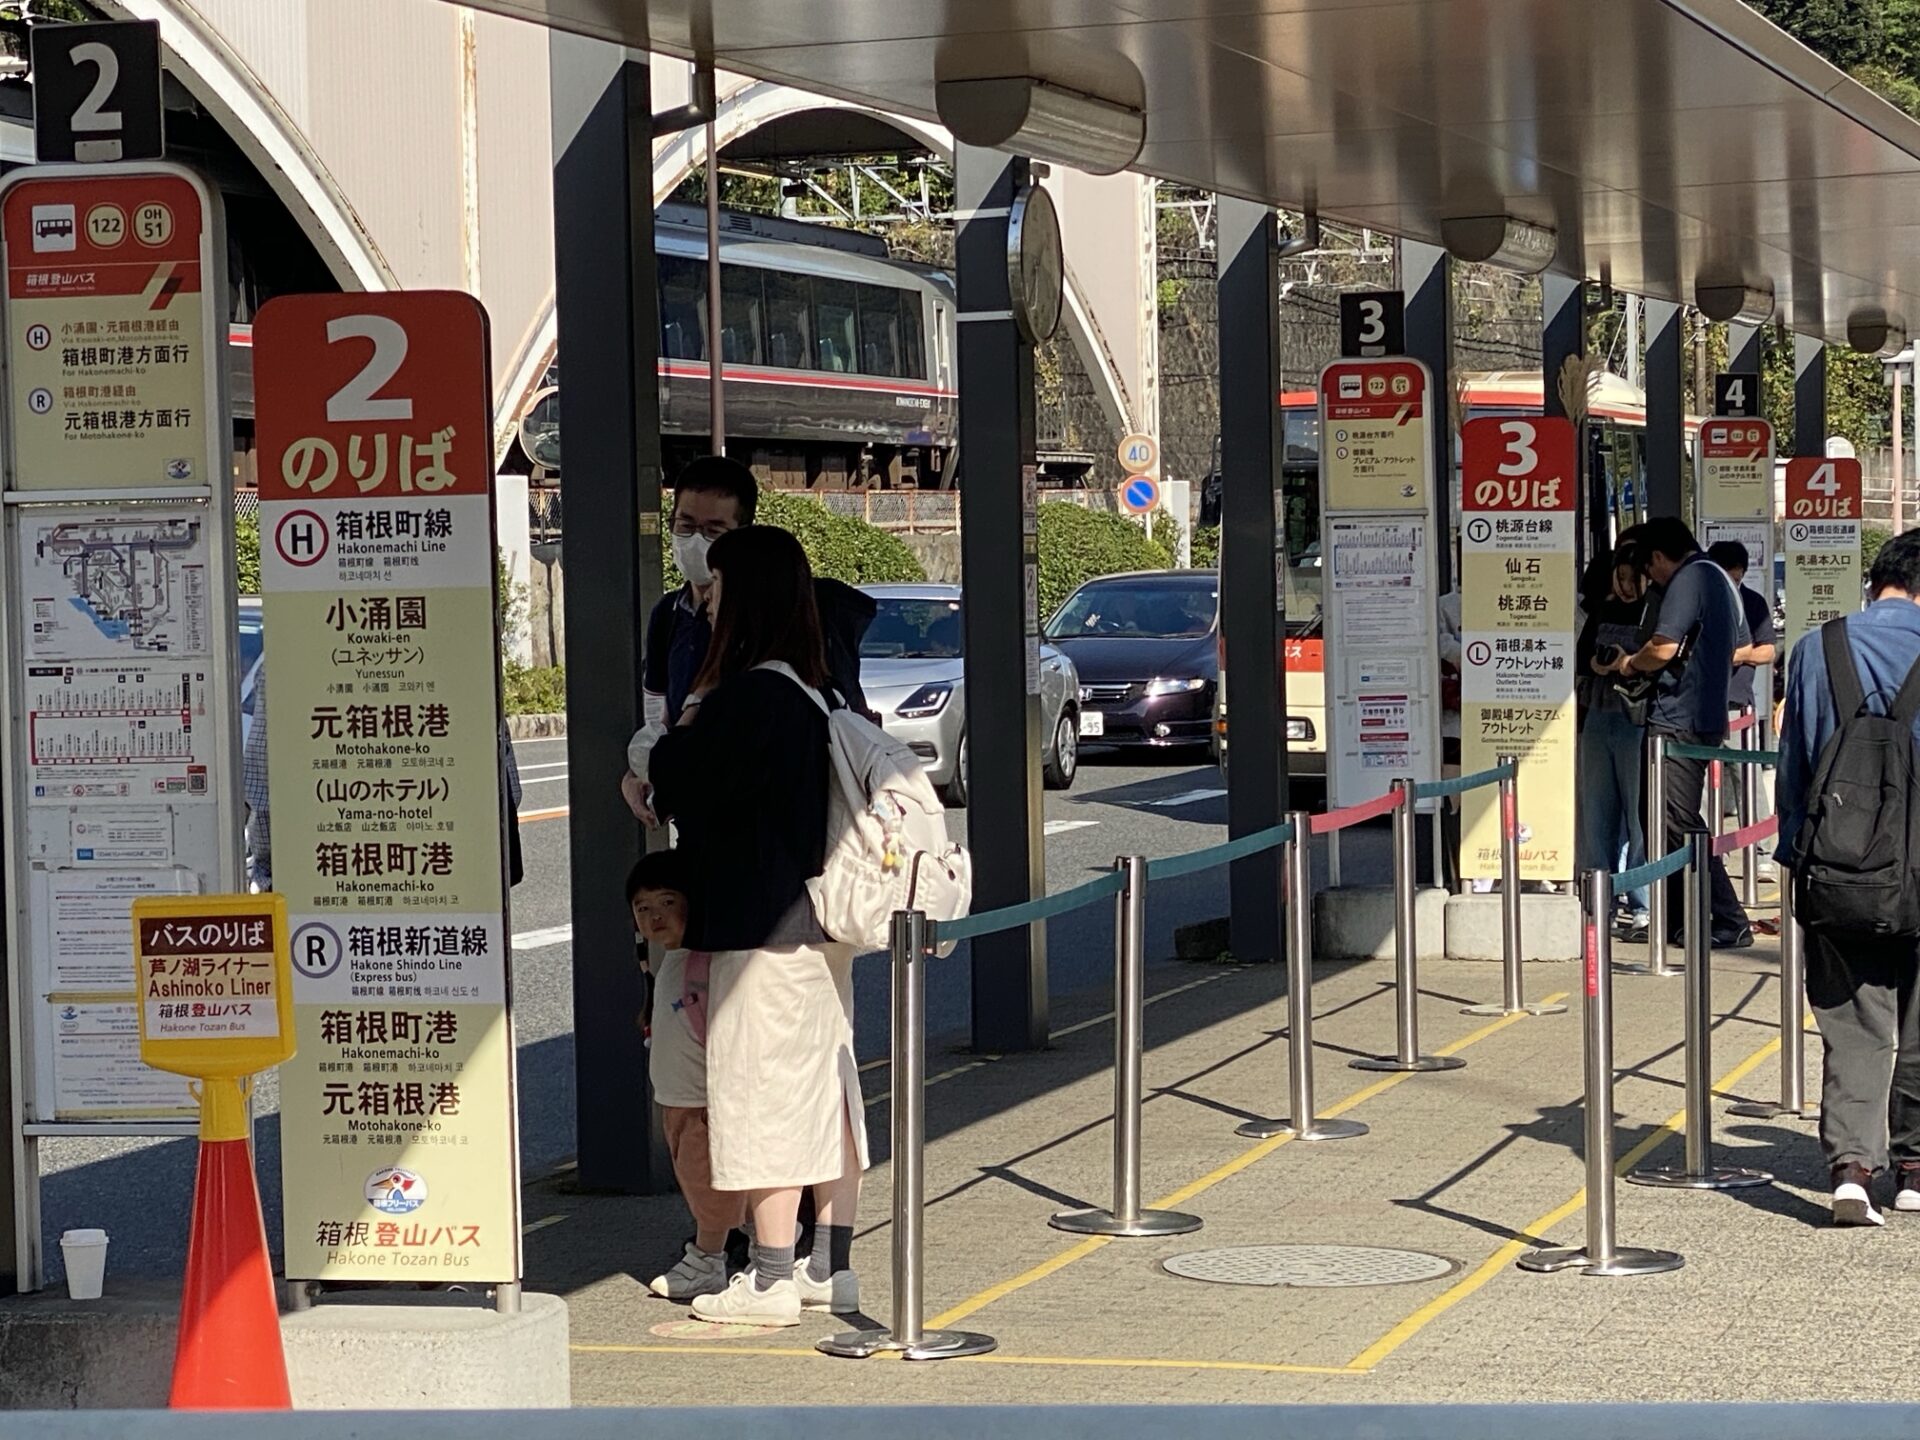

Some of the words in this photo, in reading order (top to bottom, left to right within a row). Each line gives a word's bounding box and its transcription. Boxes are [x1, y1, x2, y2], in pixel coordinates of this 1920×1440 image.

[69, 42, 122, 131] 2
[144, 209, 162, 219] OH
[92, 219, 121, 233] 122
[144, 223, 162, 238] 51
[26, 272, 95, 286] 箱根登山バス
[1359, 300, 1385, 343] 3
[34, 332, 43, 344] H
[62, 344, 189, 367] 箱根町港方面行
[62, 369, 75, 377] For
[78, 366, 146, 376] Hakonemachi-ko
[326, 314, 413, 422] 2
[63, 384, 136, 398] 箱根町港経由
[1370, 381, 1384, 390] 122
[1725, 379, 1746, 407] 4
[36, 394, 46, 408] R
[64, 409, 191, 431] 元箱根港方面行
[64, 433, 78, 441] For
[80, 431, 145, 440] Motohakone-ko
[1128, 445, 1149, 463] 40
[1498, 421, 1538, 476] 3
[282, 425, 457, 494] のりば
[1807, 463, 1841, 497] 4
[1475, 477, 1561, 508] のりば
[1793, 497, 1852, 517] のりば
[335, 508, 452, 541] 箱根町線
[1475, 525, 1484, 538] T
[1496, 519, 1553, 533] 桃源台線
[291, 523, 314, 555] H
[1796, 527, 1803, 538] K
[337, 541, 418, 555] Hakonemachi
[421, 540, 446, 553] Line
[1506, 558, 1541, 574] 仙石
[1796, 554, 1851, 566] 奥湯本入口
[1812, 584, 1834, 595] 畑宿
[1498, 594, 1549, 611] 桃源台
[326, 596, 426, 631] 小涌園
[347, 632, 410, 644] Kowaki-en
[1476, 647, 1484, 660] L
[1495, 656, 1564, 670] アウトレット線
[355, 668, 405, 679] Yunessun
[311, 703, 450, 739] 元箱根港
[1482, 722, 1534, 735] アウトレット
[335, 742, 430, 756] Motohakone-ko
[337, 806, 433, 820] Yama-no-hotel
[316, 842, 453, 877] 箱根町港
[1478, 848, 1558, 861] 箱根山バス
[336, 881, 435, 892] Hakonemachi-ko
[150, 921, 265, 947] バスのりば
[348, 926, 488, 956] 箱根新道線
[306, 935, 326, 967] R
[149, 956, 269, 978] 芦ノ湖ライナー
[350, 959, 393, 971] Hakone
[397, 958, 435, 970] Shindo
[439, 958, 462, 970] Line
[350, 972, 393, 984] (Express
[395, 971, 417, 983] bus)
[149, 978, 224, 997] Ashinoko
[231, 978, 271, 996] Liner
[158, 1003, 252, 1018] 箱根登山バス
[160, 1023, 196, 1032] Hakone
[200, 1022, 227, 1032] Tozan
[229, 1022, 246, 1031] Bus
[320, 1010, 458, 1044] 箱根町港
[342, 1047, 440, 1059] Hakonemachi-ko
[323, 1081, 461, 1116] 元箱根港
[348, 1119, 441, 1131] Motohakone-ko
[316, 1221, 480, 1247] 箱根登山バス
[327, 1251, 385, 1265] Hakone
[392, 1252, 437, 1266] Tozan
[443, 1252, 470, 1267] Bus
